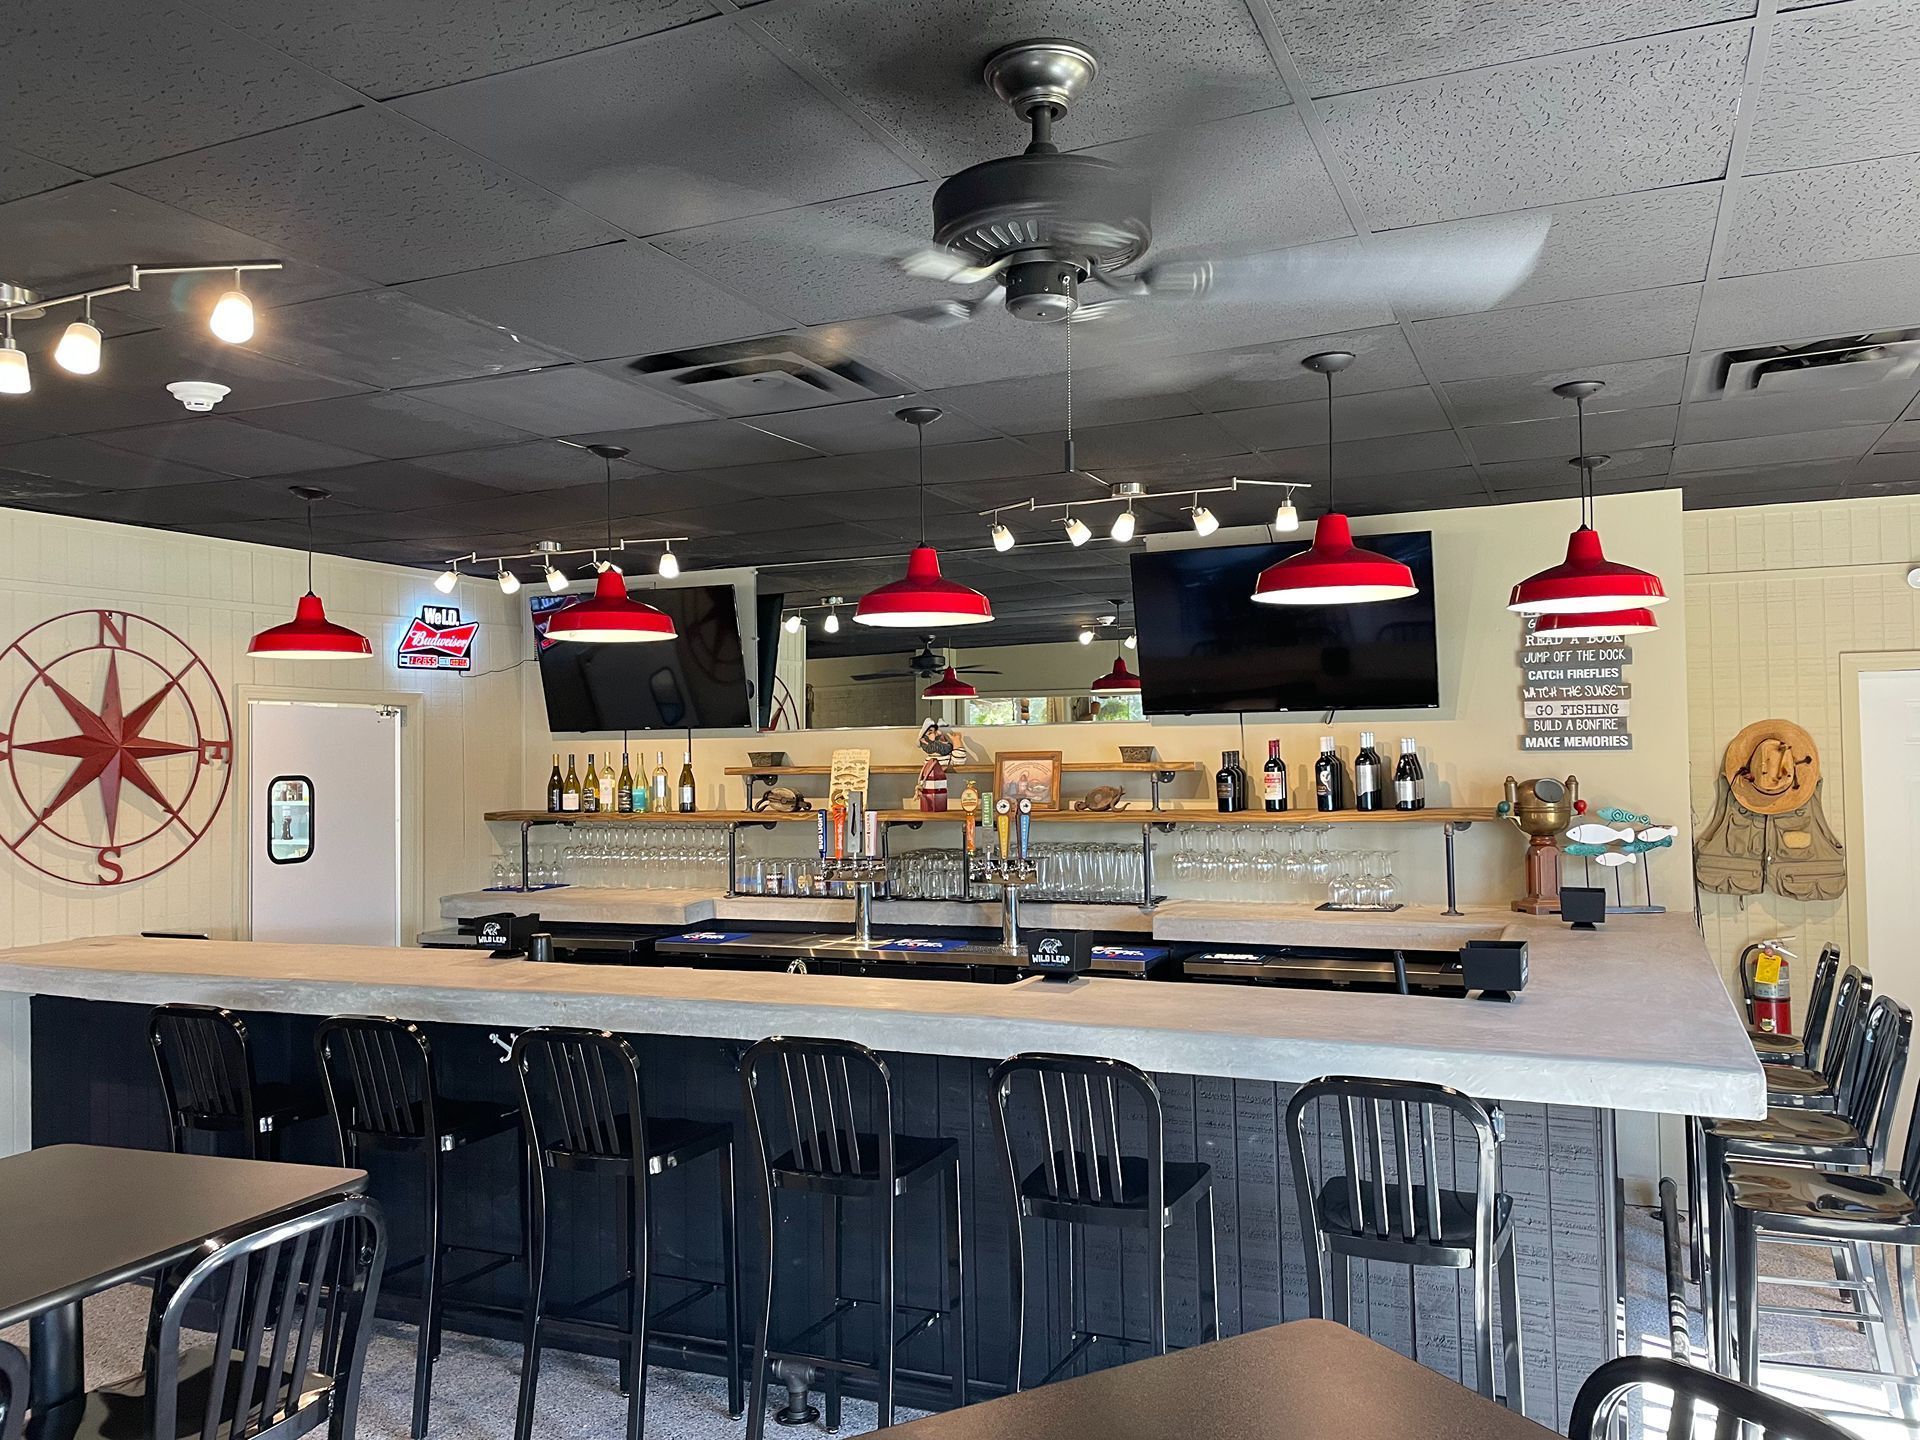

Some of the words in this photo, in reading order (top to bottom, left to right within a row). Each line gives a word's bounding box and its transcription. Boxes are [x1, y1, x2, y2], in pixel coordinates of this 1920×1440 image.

[410, 631, 468, 648] Budweiser
[1525, 635, 1564, 647] READ
[1570, 637, 1580, 645] A
[1587, 635, 1623, 644] BOOK
[1524, 651, 1551, 664] JUMP
[1553, 650, 1573, 663] OFF
[1576, 649, 1596, 662] THE
[1599, 648, 1626, 661] DOCK
[1528, 669, 1564, 681] CATCH
[1567, 668, 1619, 680] FIREFLIES
[1523, 686, 1557, 699] WATCH
[1559, 686, 1583, 697] THE
[1584, 684, 1629, 697] SUNSET
[1535, 705, 1554, 716] GO
[1560, 703, 1619, 716] FISHING
[1534, 719, 1562, 732] BUILD
[1565, 719, 1574, 731] A
[1576, 718, 1619, 731] BONFIRE
[1525, 736, 1561, 748] MAKE
[1564, 735, 1629, 748] MEMORIES
[478, 935, 492, 944] WILD
[1031, 954, 1050, 964] WILD
[1051, 955, 1071, 965] LEAP
